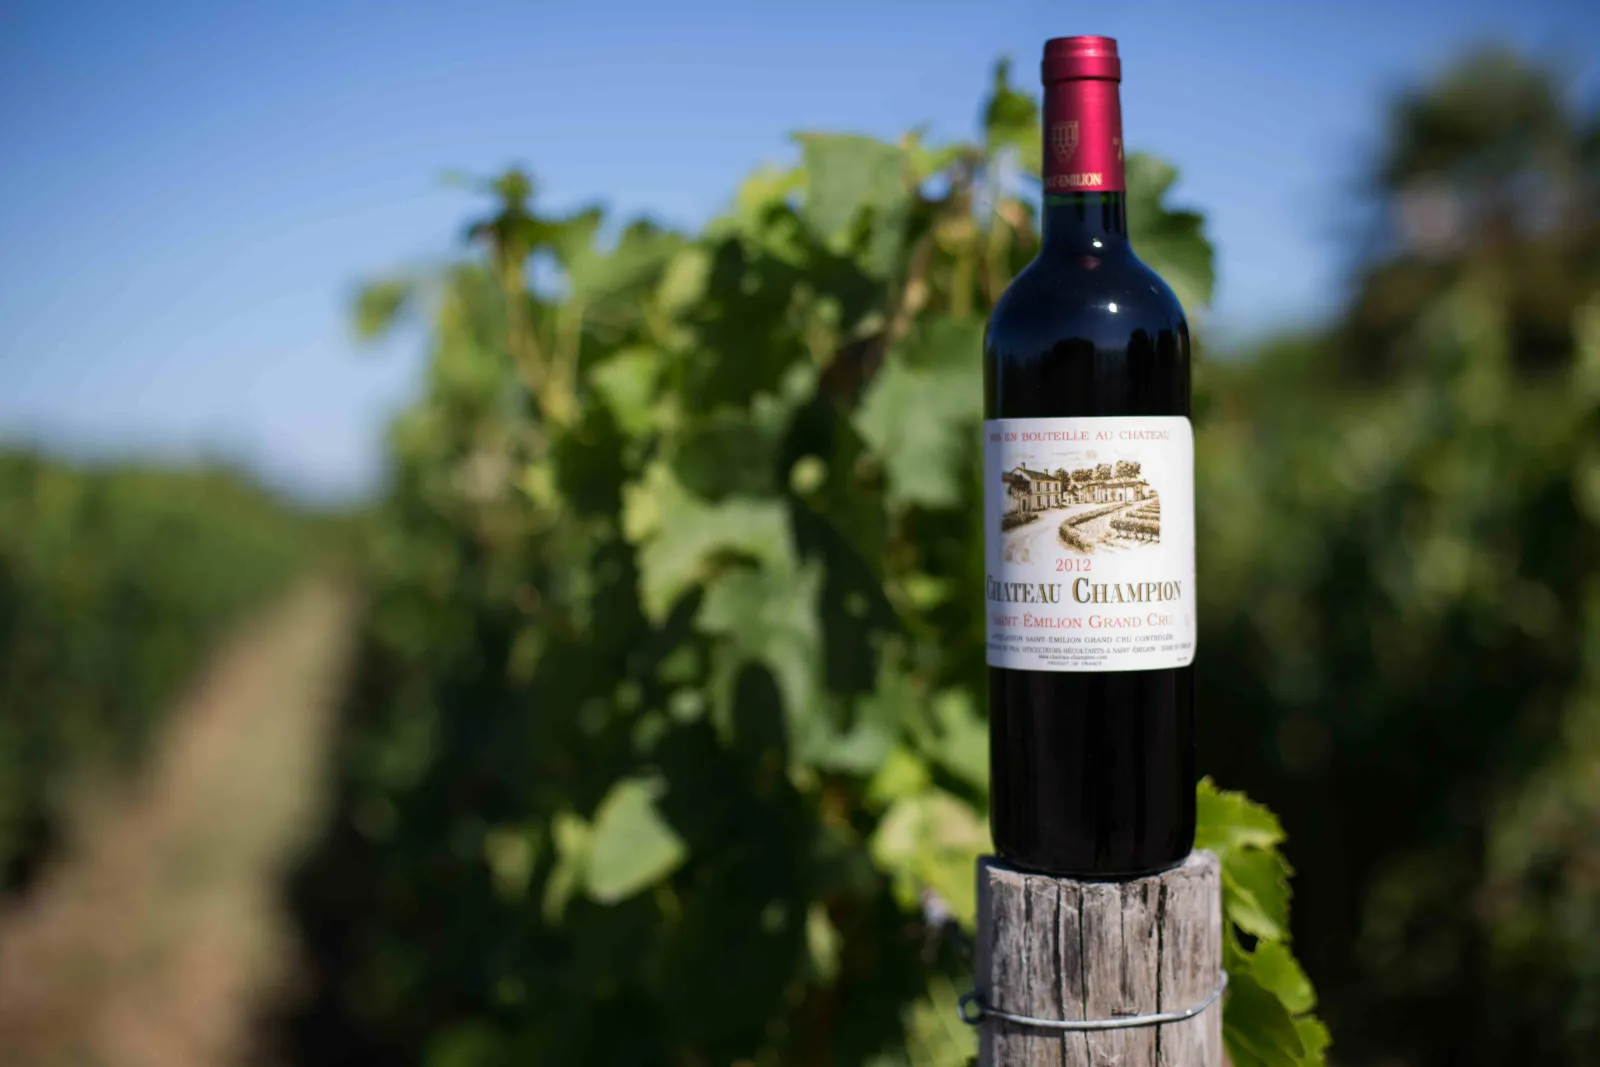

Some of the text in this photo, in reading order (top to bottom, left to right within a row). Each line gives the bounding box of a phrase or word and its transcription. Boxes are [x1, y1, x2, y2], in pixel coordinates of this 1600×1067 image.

[1004, 432, 1017, 442] EN
[1021, 430, 1089, 442] BOUTEILLE
[1095, 430, 1113, 441] AU
[1119, 430, 1170, 441] CHATEAU
[1055, 558, 1092, 573] 2012
[986, 574, 1182, 604] CHATEAU CHAMPION
[1088, 614, 1142, 629] GRAND
[1146, 612, 1173, 627] CRU
[1084, 636, 1113, 644] GRAND
[1115, 635, 1132, 643] CRU
